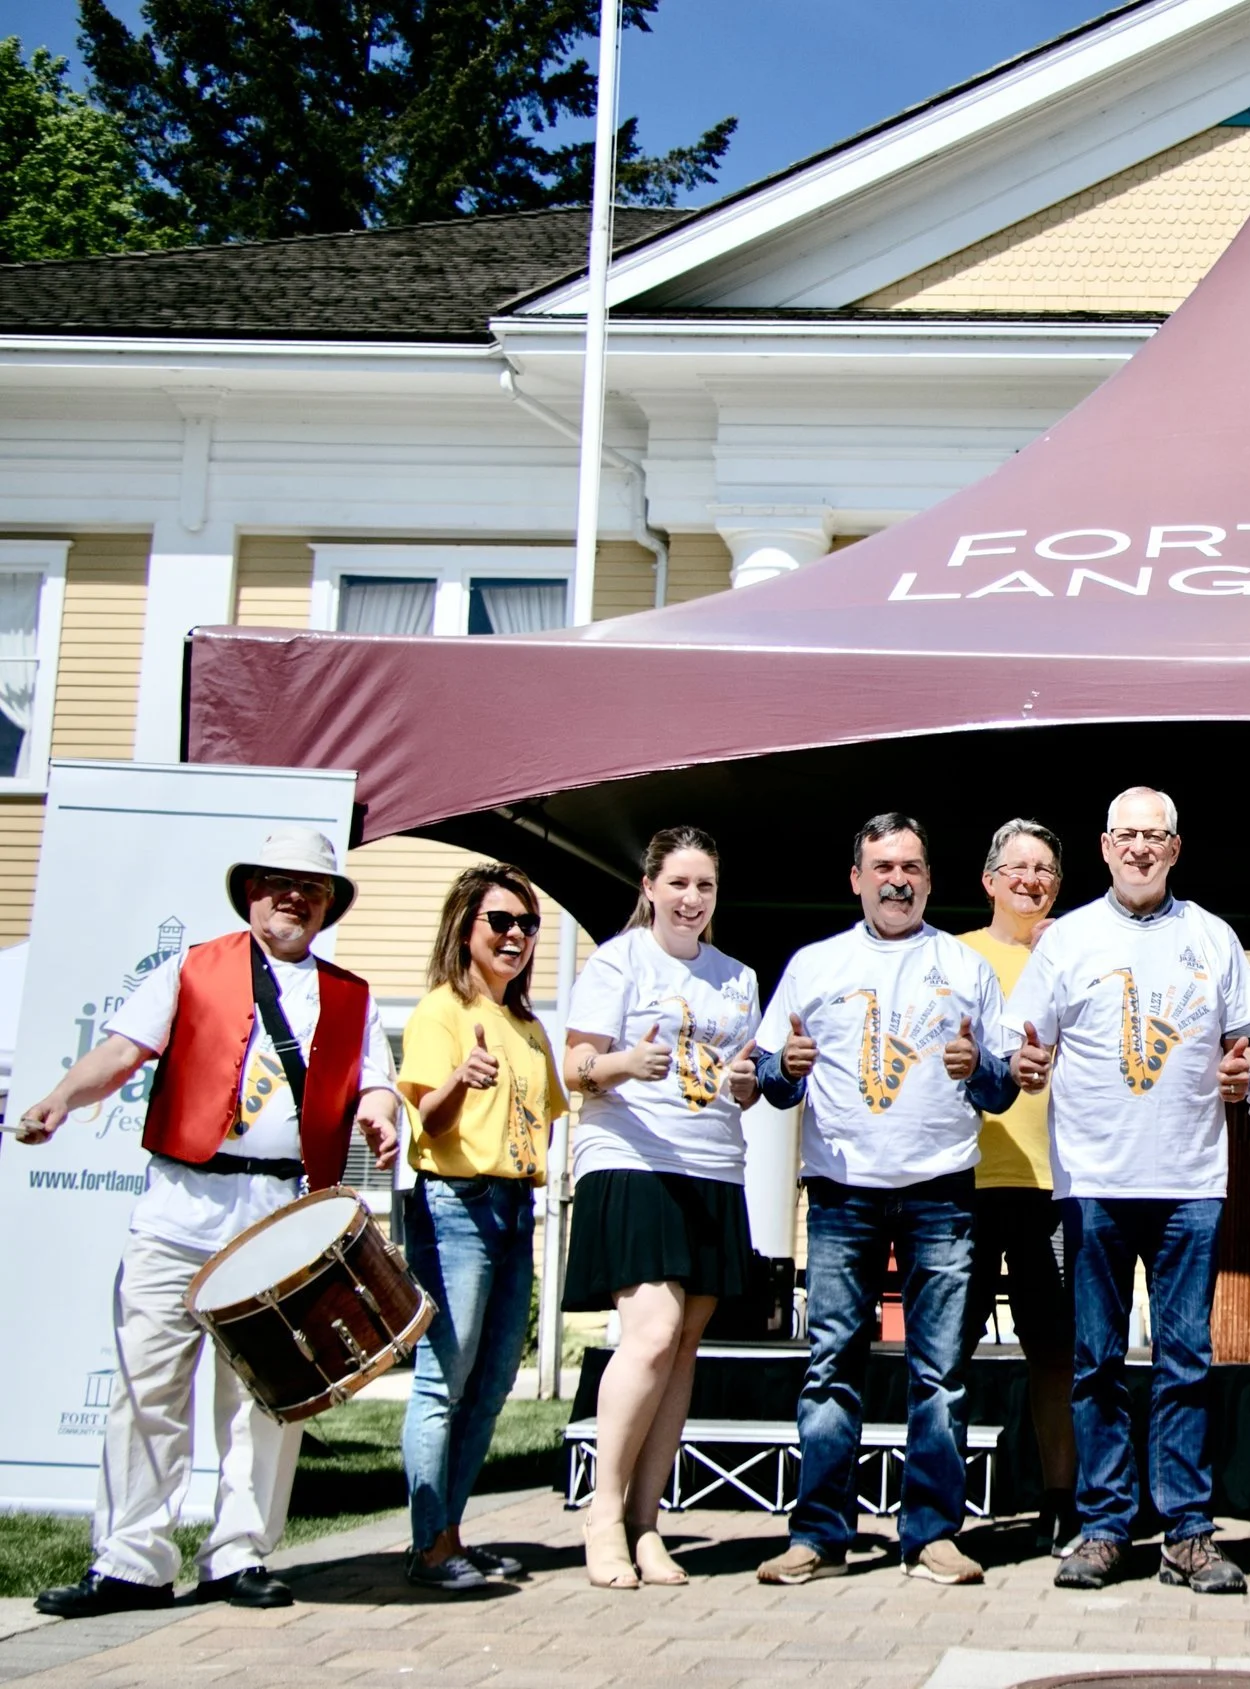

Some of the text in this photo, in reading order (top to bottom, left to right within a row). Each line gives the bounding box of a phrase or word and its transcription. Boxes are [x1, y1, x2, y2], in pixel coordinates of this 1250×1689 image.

[1149, 991, 1162, 1016] JAZZ
[888, 1010, 902, 1035] JAZZ
[1177, 1005, 1210, 1031] ARTWALK
[61, 1412, 100, 1425] FORT
